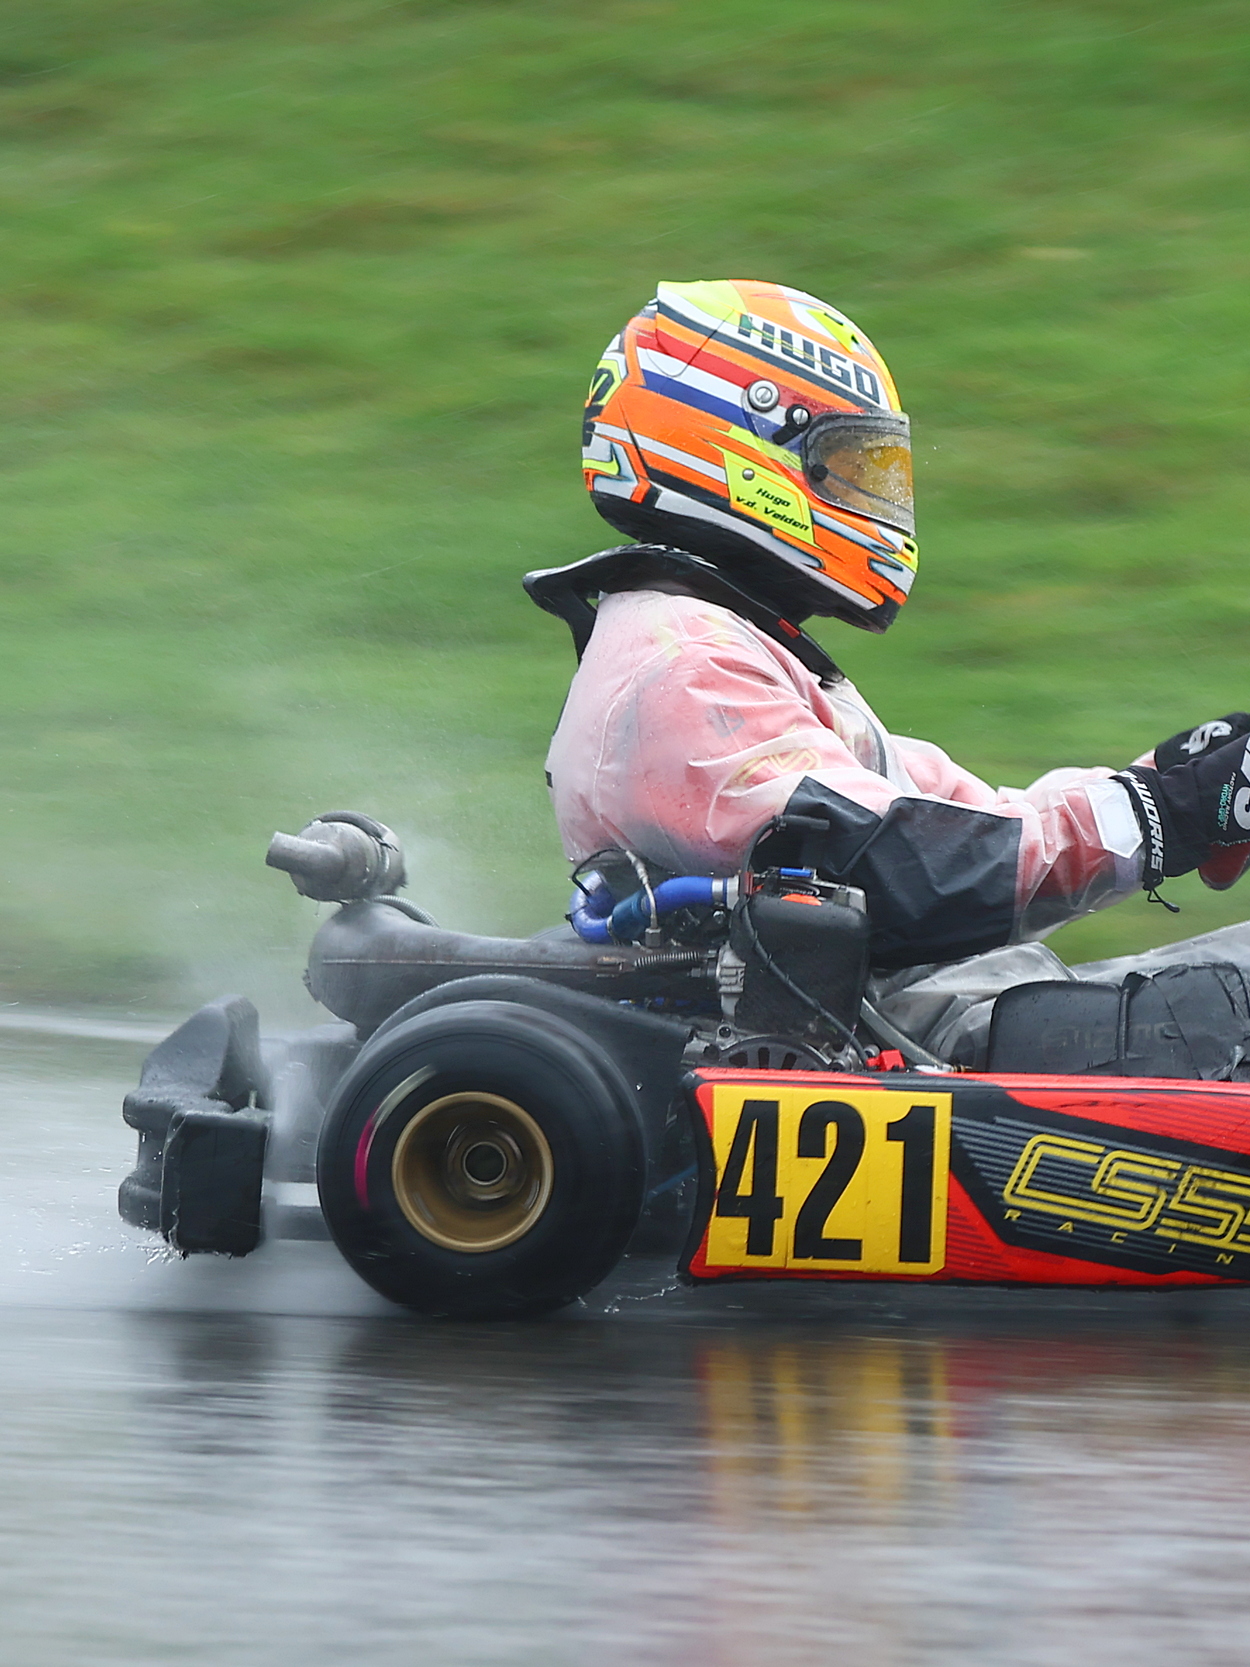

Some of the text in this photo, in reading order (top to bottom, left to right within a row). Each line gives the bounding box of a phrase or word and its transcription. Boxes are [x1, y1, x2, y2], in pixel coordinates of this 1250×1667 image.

[738, 313, 881, 405] HUGO
[736, 496, 809, 531] v.d. Velden
[756, 488, 791, 507] Hugo
[716, 1099, 938, 1263] 421
